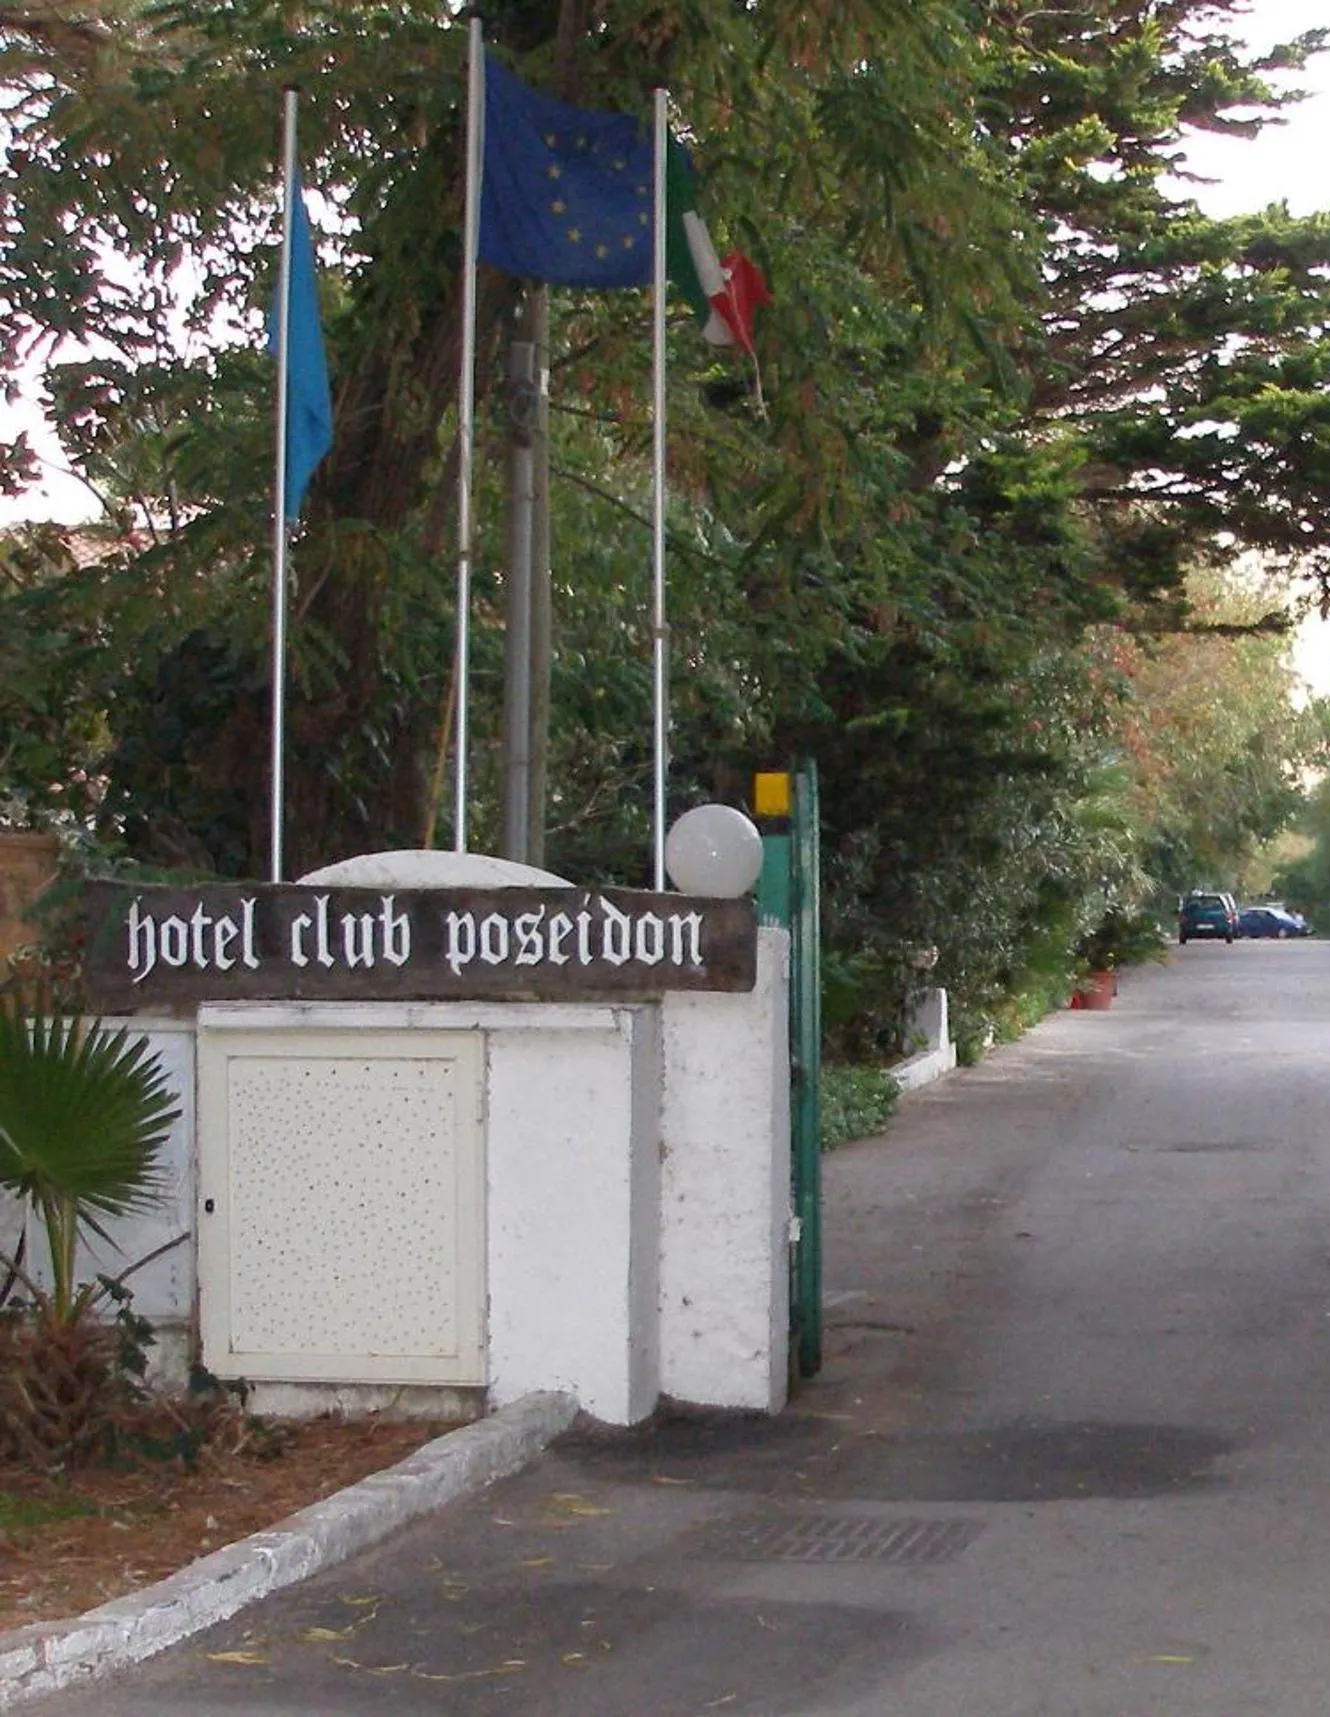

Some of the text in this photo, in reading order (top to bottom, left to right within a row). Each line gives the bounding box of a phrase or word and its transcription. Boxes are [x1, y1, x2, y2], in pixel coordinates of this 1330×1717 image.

[125, 893, 704, 983] hotel club poseidon
